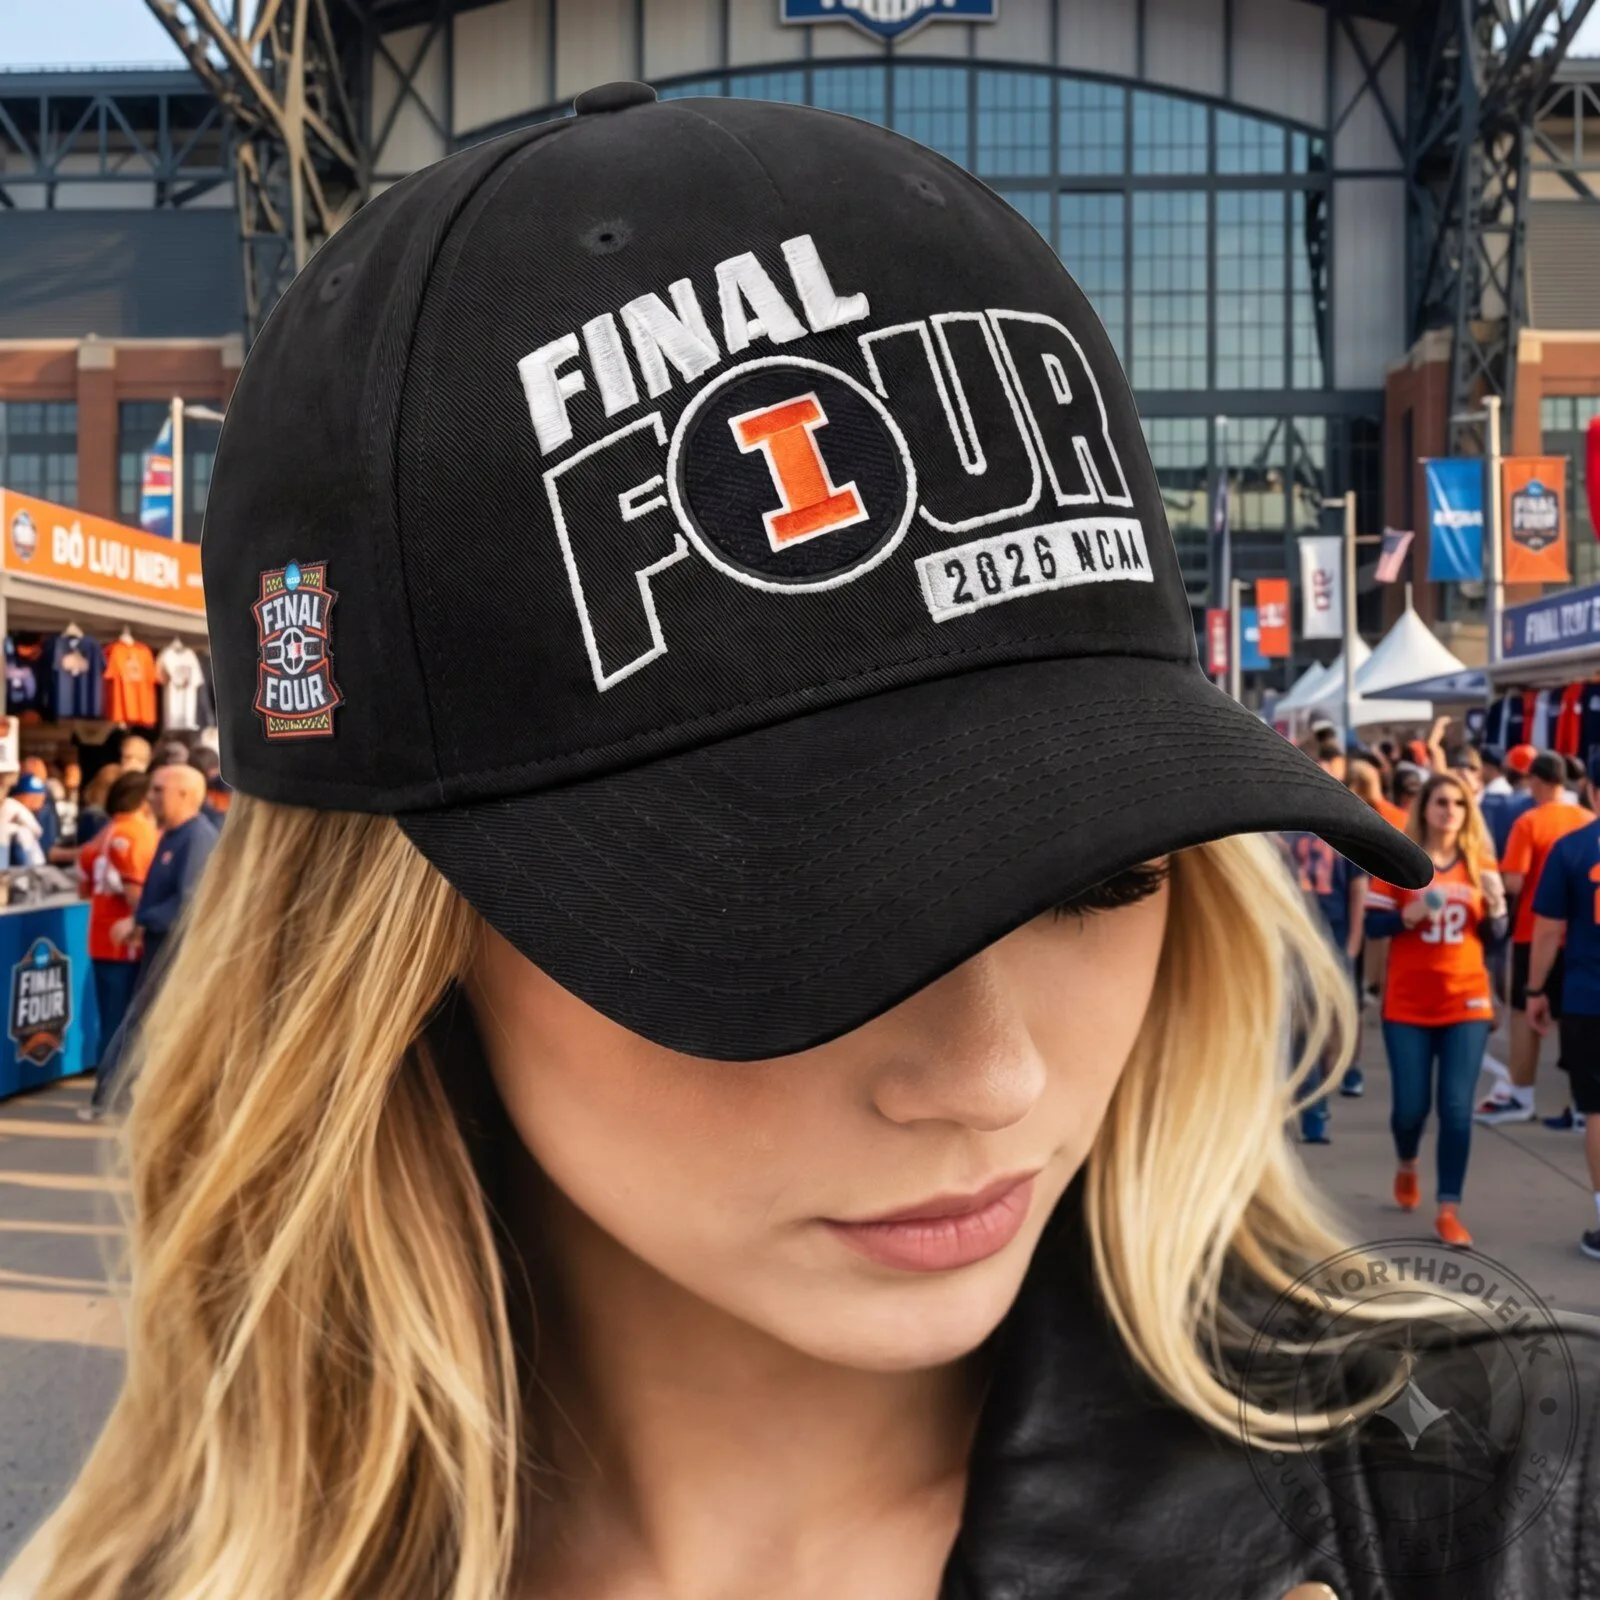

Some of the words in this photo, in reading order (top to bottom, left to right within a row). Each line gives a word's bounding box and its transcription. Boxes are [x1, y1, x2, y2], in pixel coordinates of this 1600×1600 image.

[518, 234, 869, 455] FINAL
[944, 535, 1057, 604] 2026
[1072, 528, 1144, 572] NCAA
[262, 593, 322, 635] FINAL
[265, 673, 327, 711] FOUR
[20, 966, 63, 998] FINAL
[17, 990, 65, 1027] FOUR
